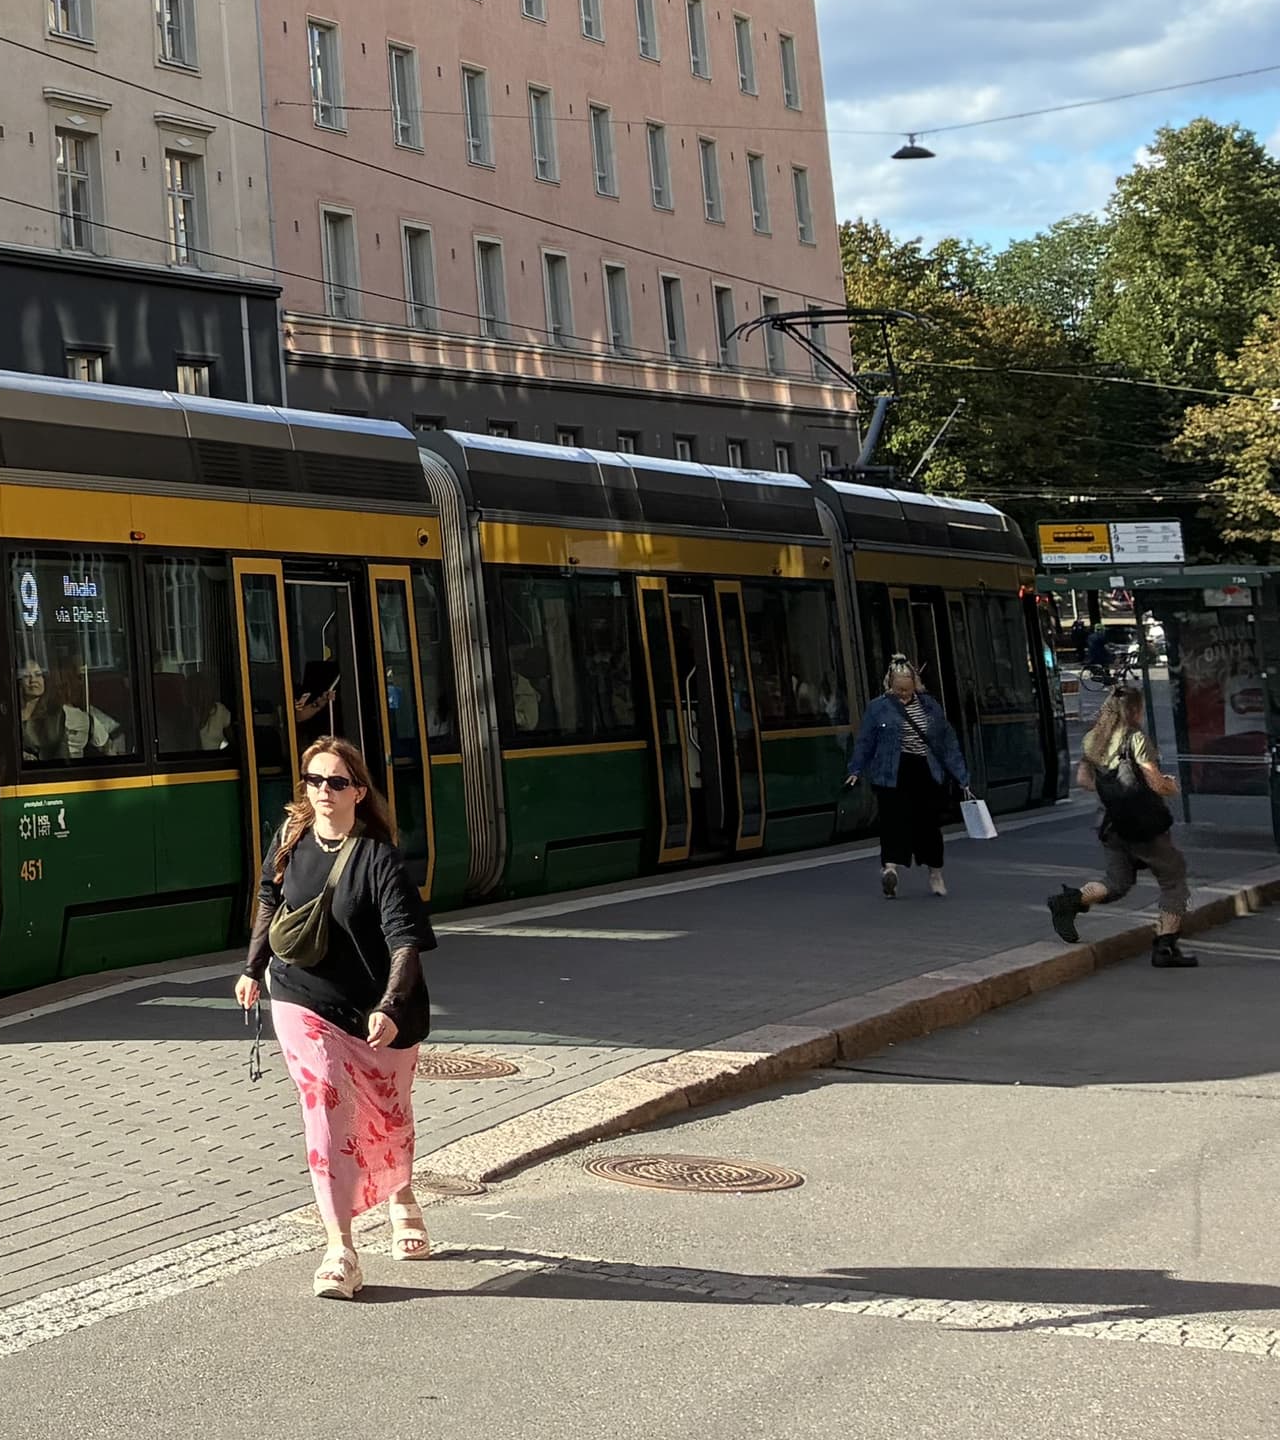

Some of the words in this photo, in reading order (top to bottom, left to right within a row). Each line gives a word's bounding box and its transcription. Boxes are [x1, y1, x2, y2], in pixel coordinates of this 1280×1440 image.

[20, 572, 38, 627] 9
[55, 606, 71, 623] via
[20, 859, 43, 881] 451
